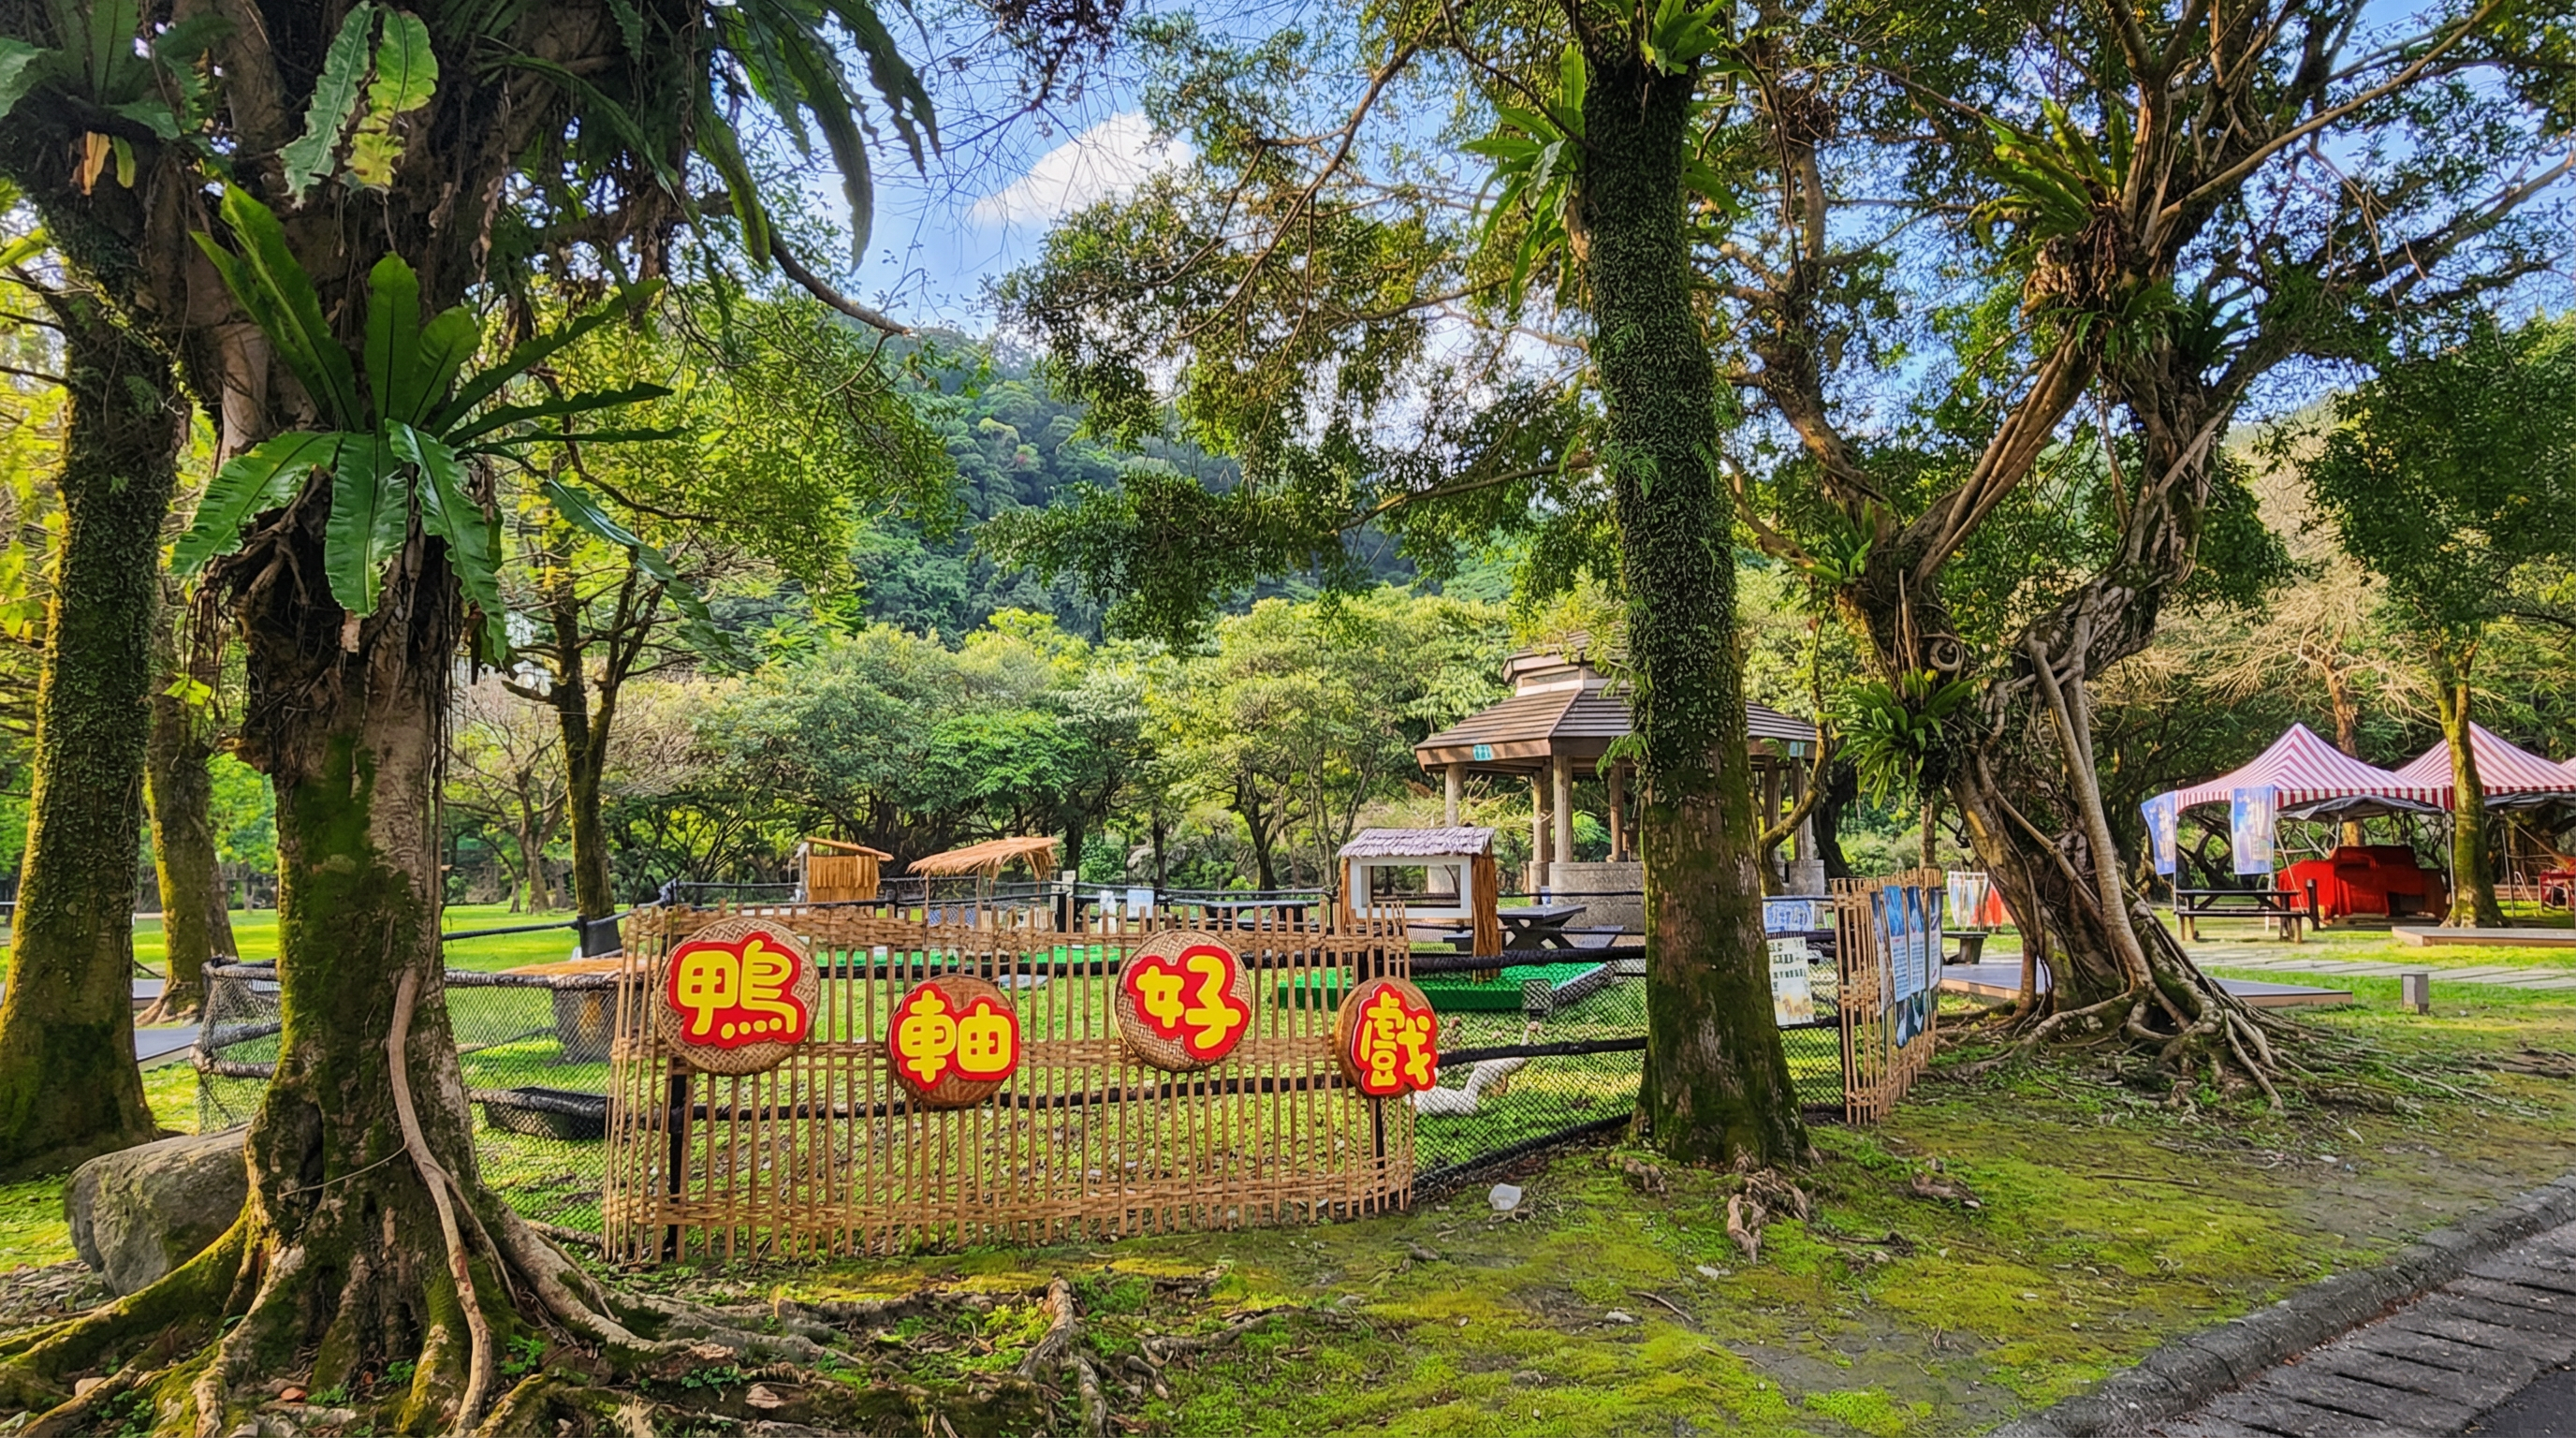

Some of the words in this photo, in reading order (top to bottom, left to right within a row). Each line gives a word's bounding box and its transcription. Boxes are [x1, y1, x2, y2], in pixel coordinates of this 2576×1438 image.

[677, 939, 798, 1040] 鴨
[898, 990, 1013, 1083] 軸
[1135, 955, 1242, 1049] 好
[1359, 990, 1431, 1087] 戲
